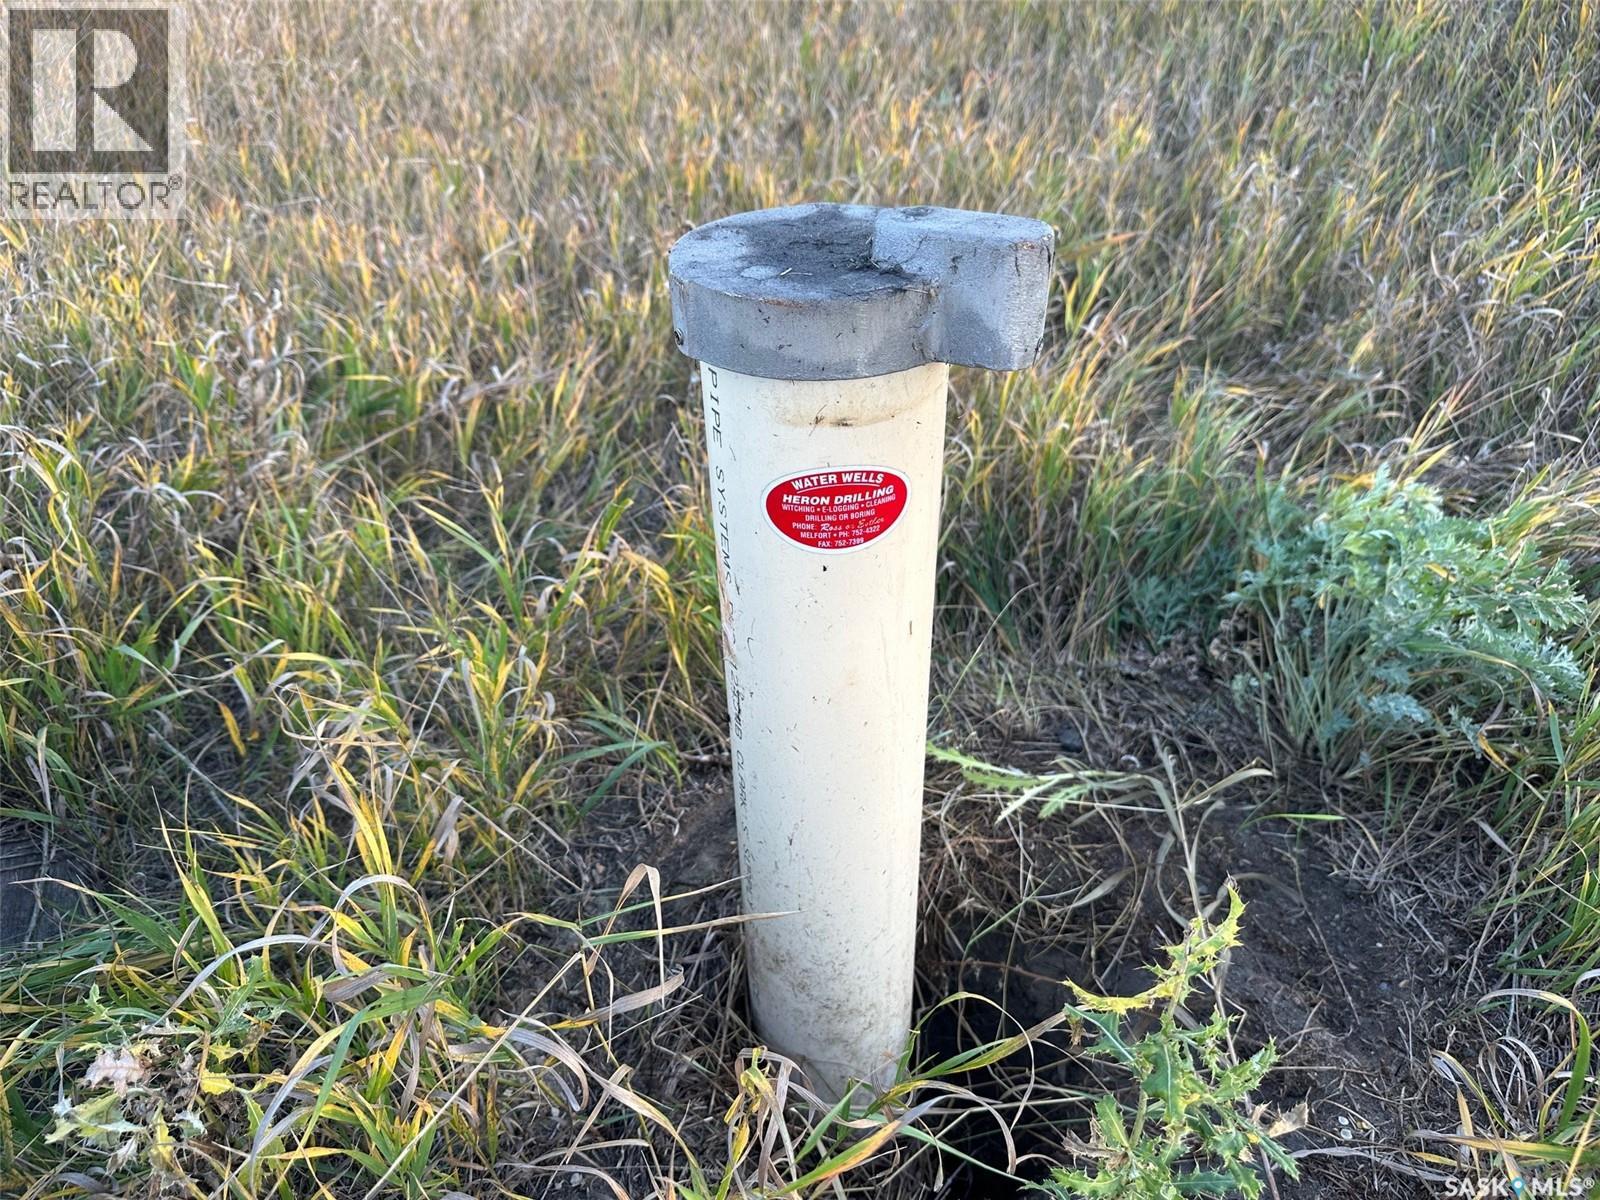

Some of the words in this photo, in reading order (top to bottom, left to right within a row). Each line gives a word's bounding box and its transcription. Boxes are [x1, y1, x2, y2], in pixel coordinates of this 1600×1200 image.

[708, 367, 723, 449] PIPE
[791, 474, 838, 491] WATER
[841, 472, 884, 484] WELLS
[782, 503, 815, 513] WITCHING
[822, 503, 859, 513] E-LOGGING
[866, 494, 896, 508] CLEANING
[783, 494, 830, 505] HERON
[834, 485, 894, 505] DRILLING
[805, 513, 837, 522] DRILLING
[839, 512, 849, 521] OR
[850, 508, 876, 519] BORING
[800, 531, 831, 539] MELFORT
[820, 523, 842, 532] Ross
